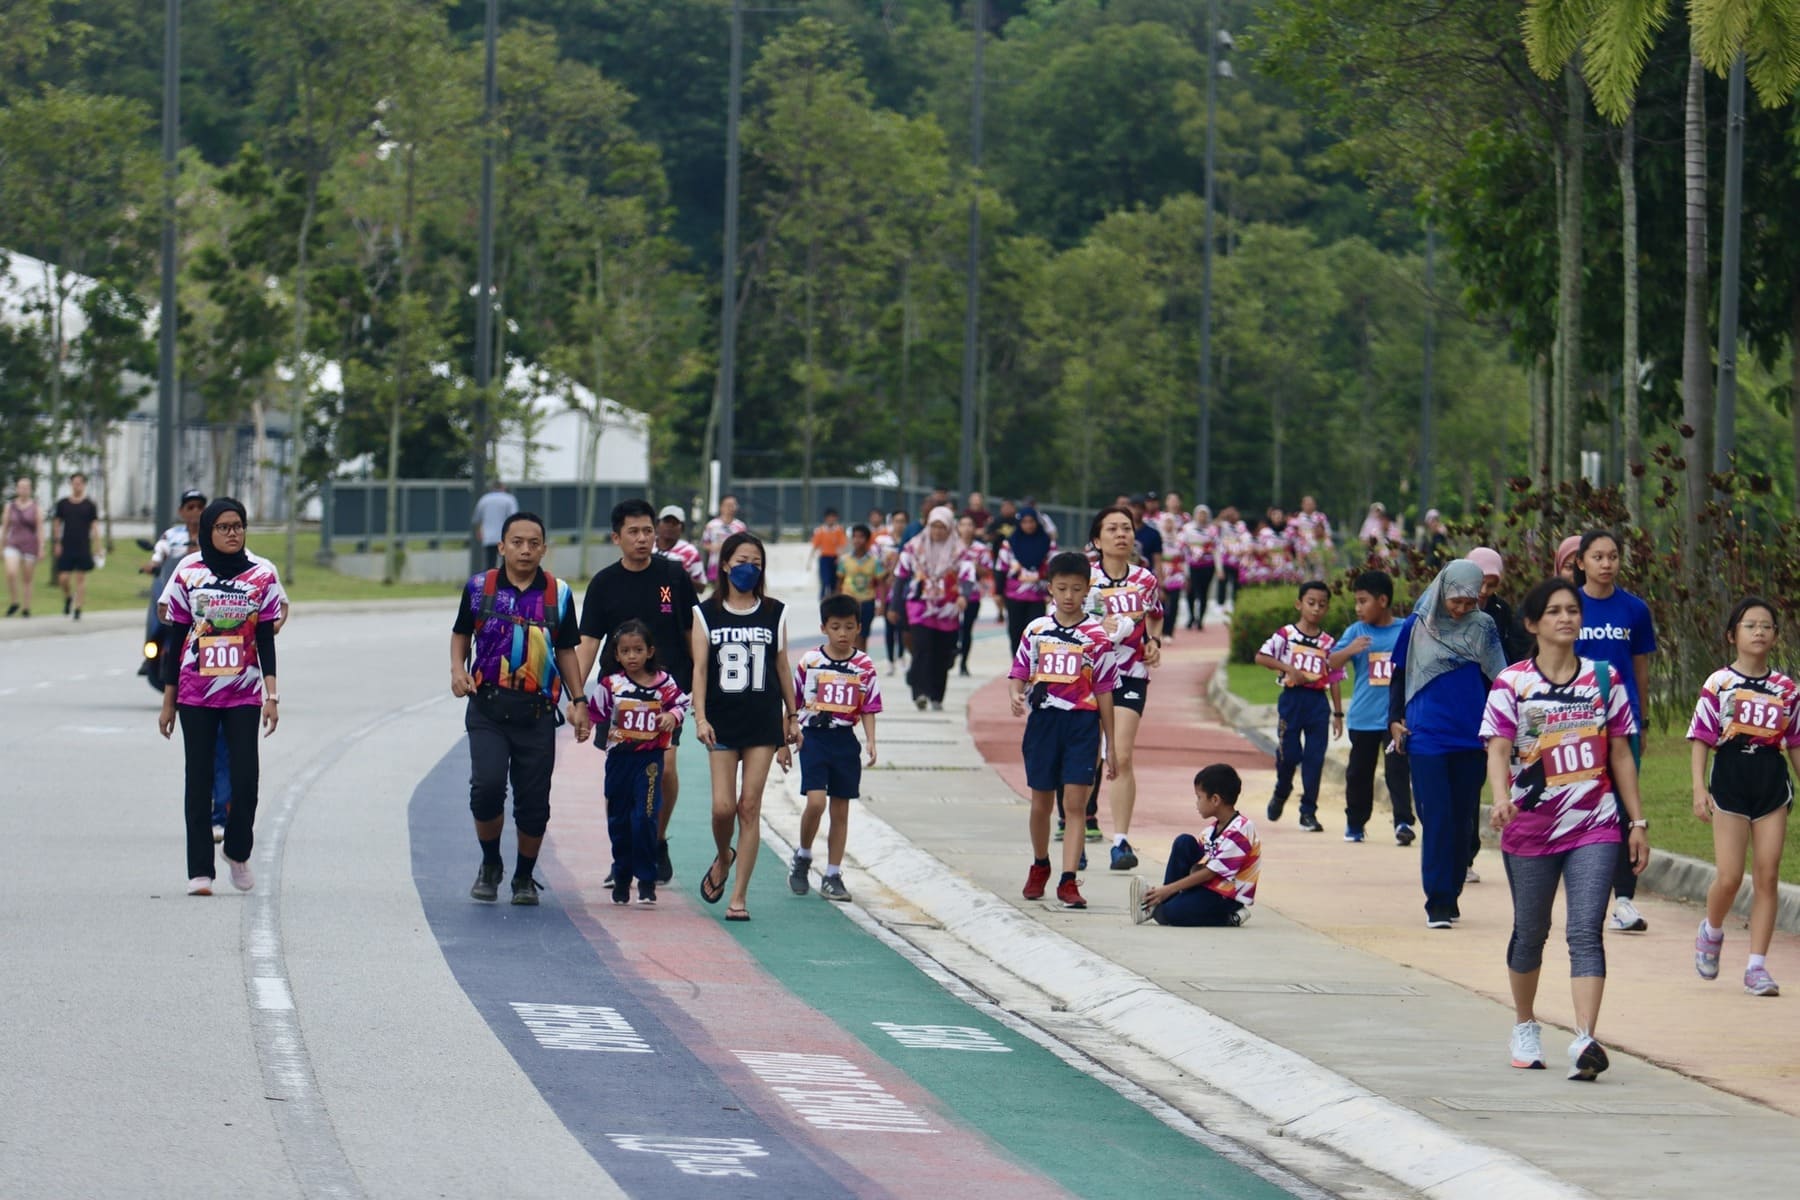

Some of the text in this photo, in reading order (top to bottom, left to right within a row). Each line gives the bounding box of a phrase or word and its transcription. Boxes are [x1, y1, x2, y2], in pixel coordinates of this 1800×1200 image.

[1109, 594, 1137, 613] 387
[711, 627, 772, 645] STONES
[205, 647, 239, 667] 200
[717, 642, 766, 693] 81
[1044, 654, 1077, 675] 350
[1294, 653, 1322, 674] 345
[1373, 661, 1397, 678] 44
[823, 684, 854, 705] 351
[624, 711, 656, 732] 346
[1546, 711, 1595, 725] KLSC
[1739, 701, 1778, 729] 352
[1551, 742, 1595, 774] 106
[771, 1086, 943, 1134] SEMULA
